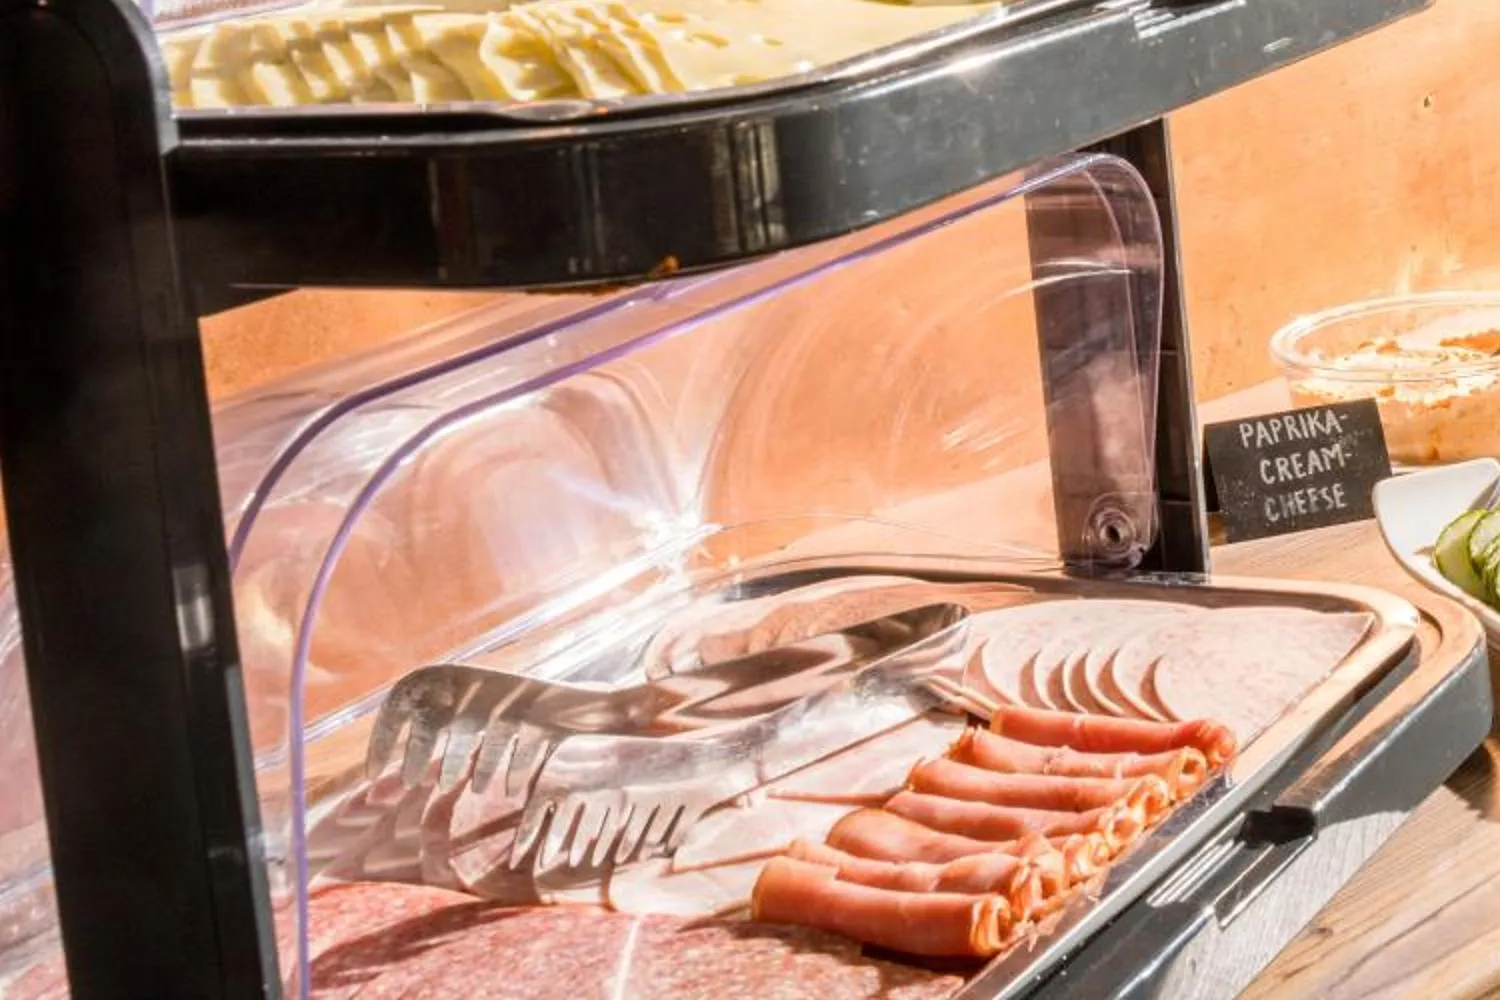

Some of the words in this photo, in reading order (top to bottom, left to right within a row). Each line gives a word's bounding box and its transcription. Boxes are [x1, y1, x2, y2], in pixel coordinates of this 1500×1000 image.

[1239, 408, 1349, 449] PAPRIKA-
[1260, 443, 1353, 485] CREAM-
[1264, 483, 1348, 521] CHEESE
